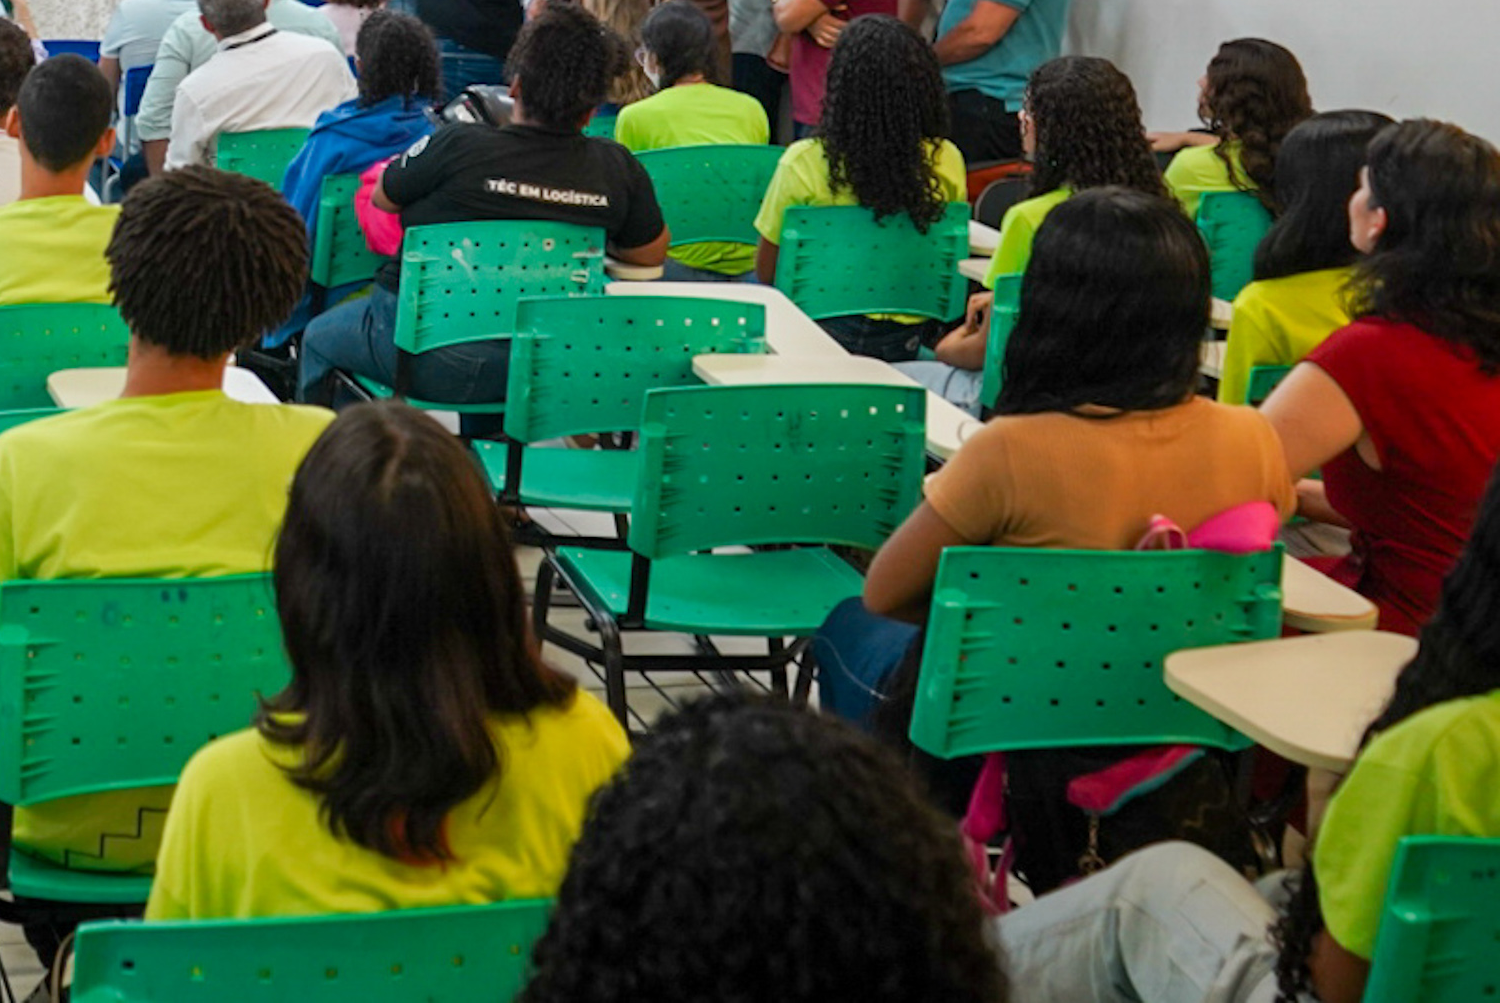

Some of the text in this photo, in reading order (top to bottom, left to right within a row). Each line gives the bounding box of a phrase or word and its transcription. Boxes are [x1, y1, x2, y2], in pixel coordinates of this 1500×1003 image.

[487, 178, 609, 207] TÉC EM LOGÍSTICA
